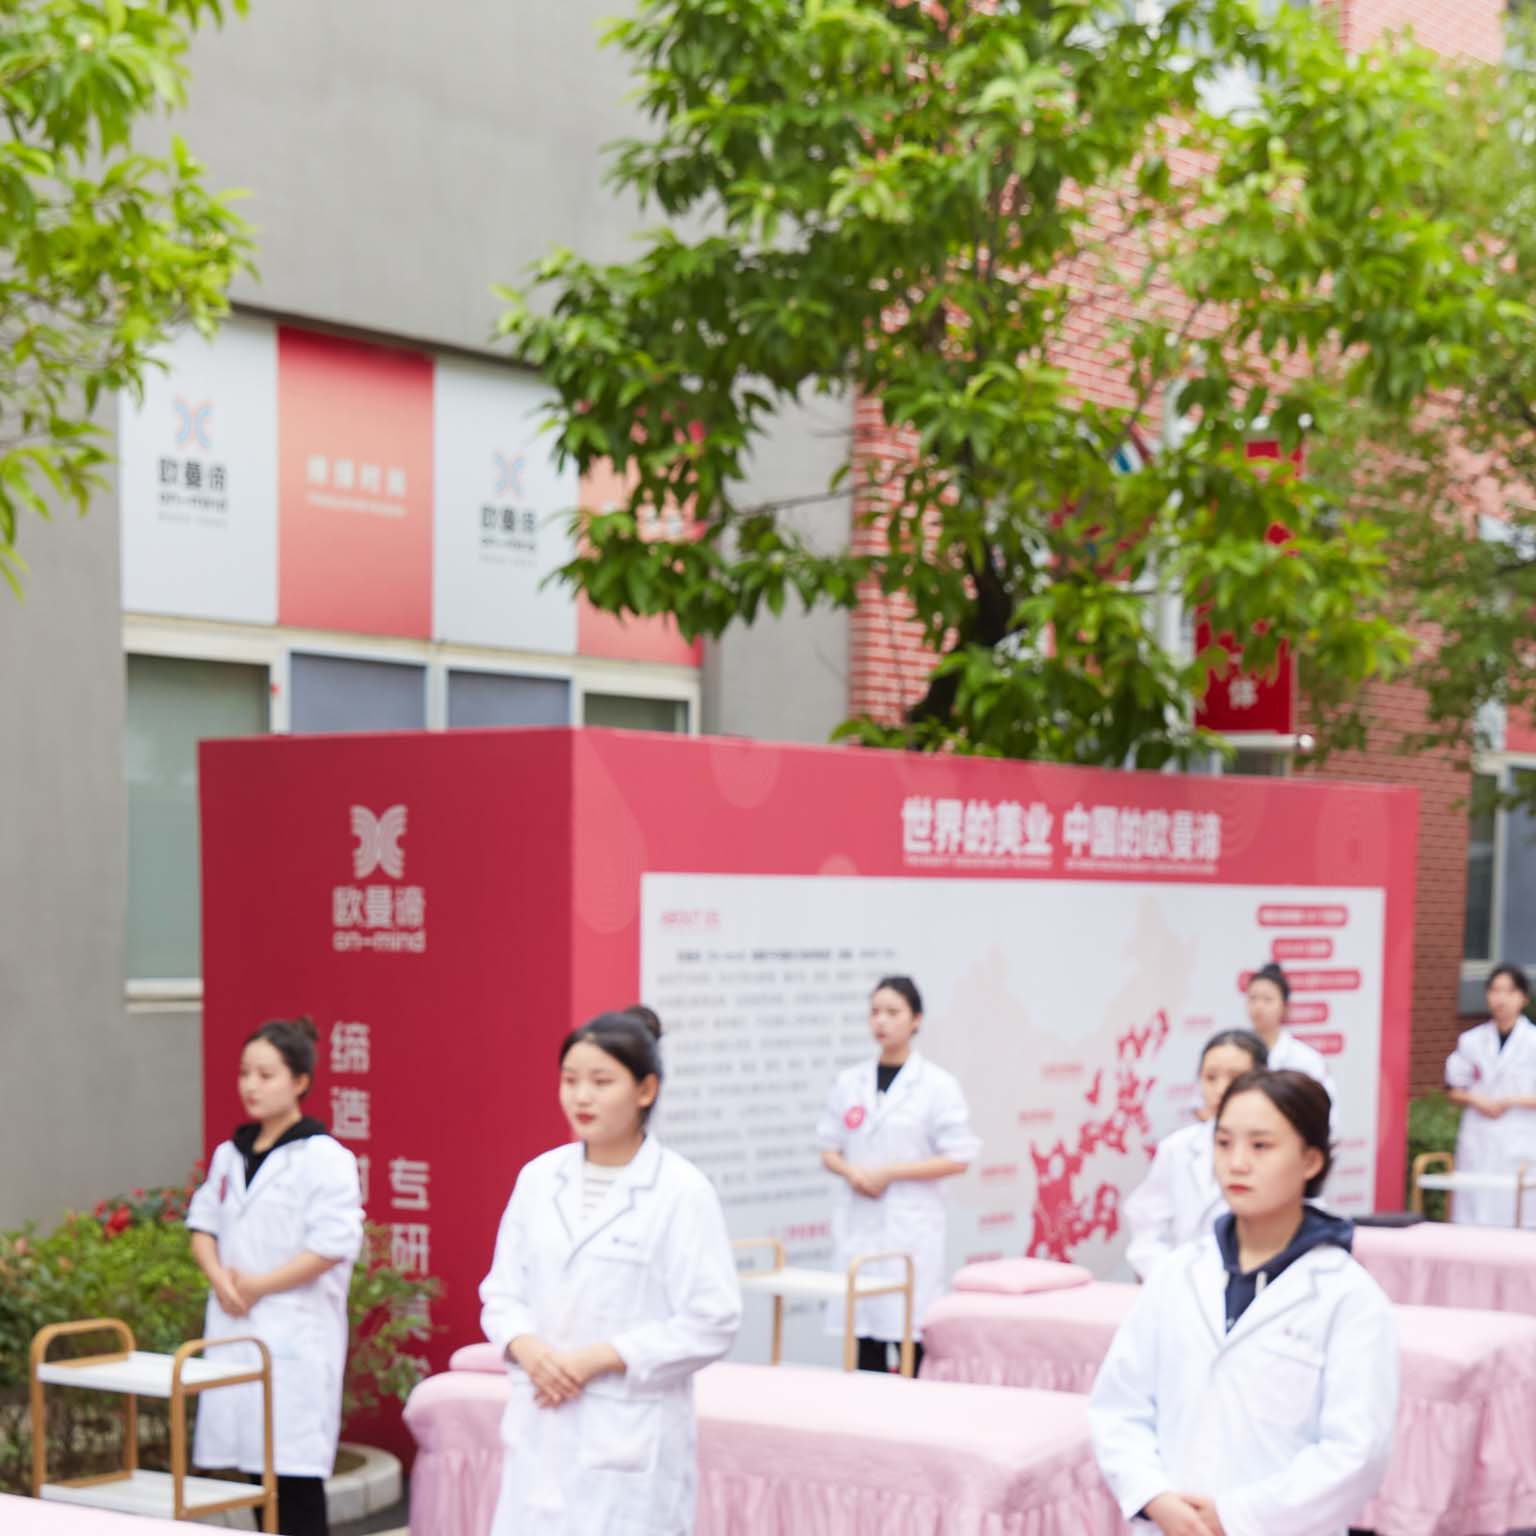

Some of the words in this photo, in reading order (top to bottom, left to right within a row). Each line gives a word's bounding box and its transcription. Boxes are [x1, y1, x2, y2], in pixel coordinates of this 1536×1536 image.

[902, 797, 1053, 855] 世界的美业
[333, 885, 425, 928] 欧曼谛
